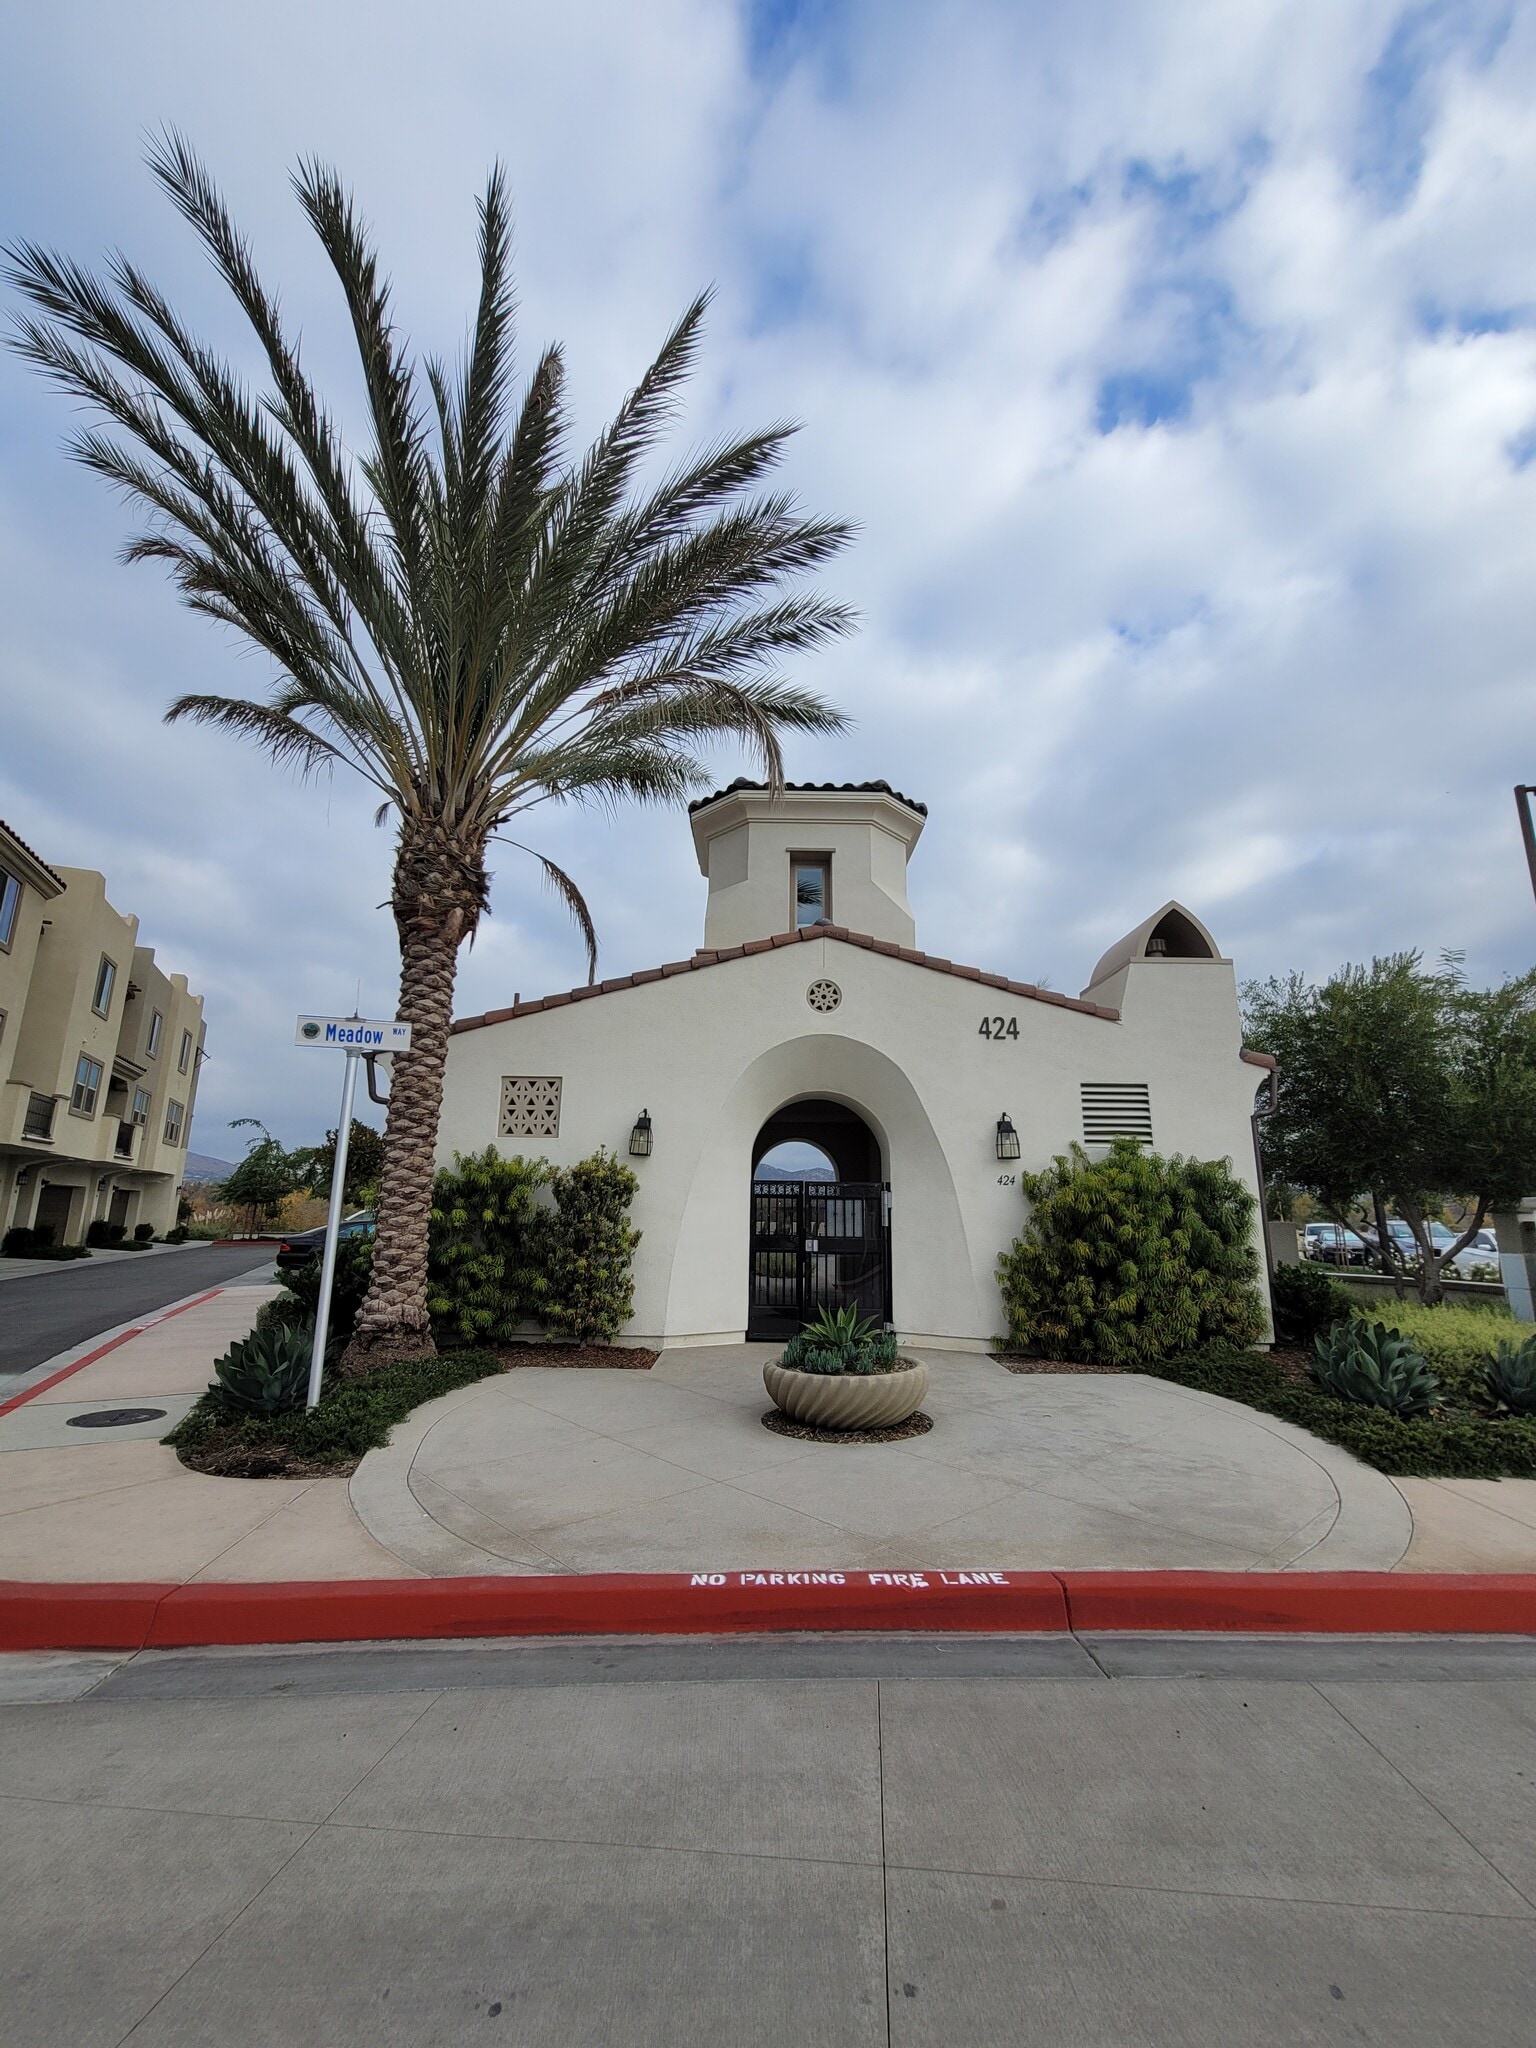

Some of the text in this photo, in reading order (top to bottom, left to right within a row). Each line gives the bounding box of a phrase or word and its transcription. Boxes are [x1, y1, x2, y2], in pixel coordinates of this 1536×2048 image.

[325, 1023, 407, 1045] Meadow WAY
[978, 1016, 1020, 1040] 424
[997, 1174, 1016, 1186] 424
[690, 1572, 1010, 1587] NO PARKING FIRE LANE
